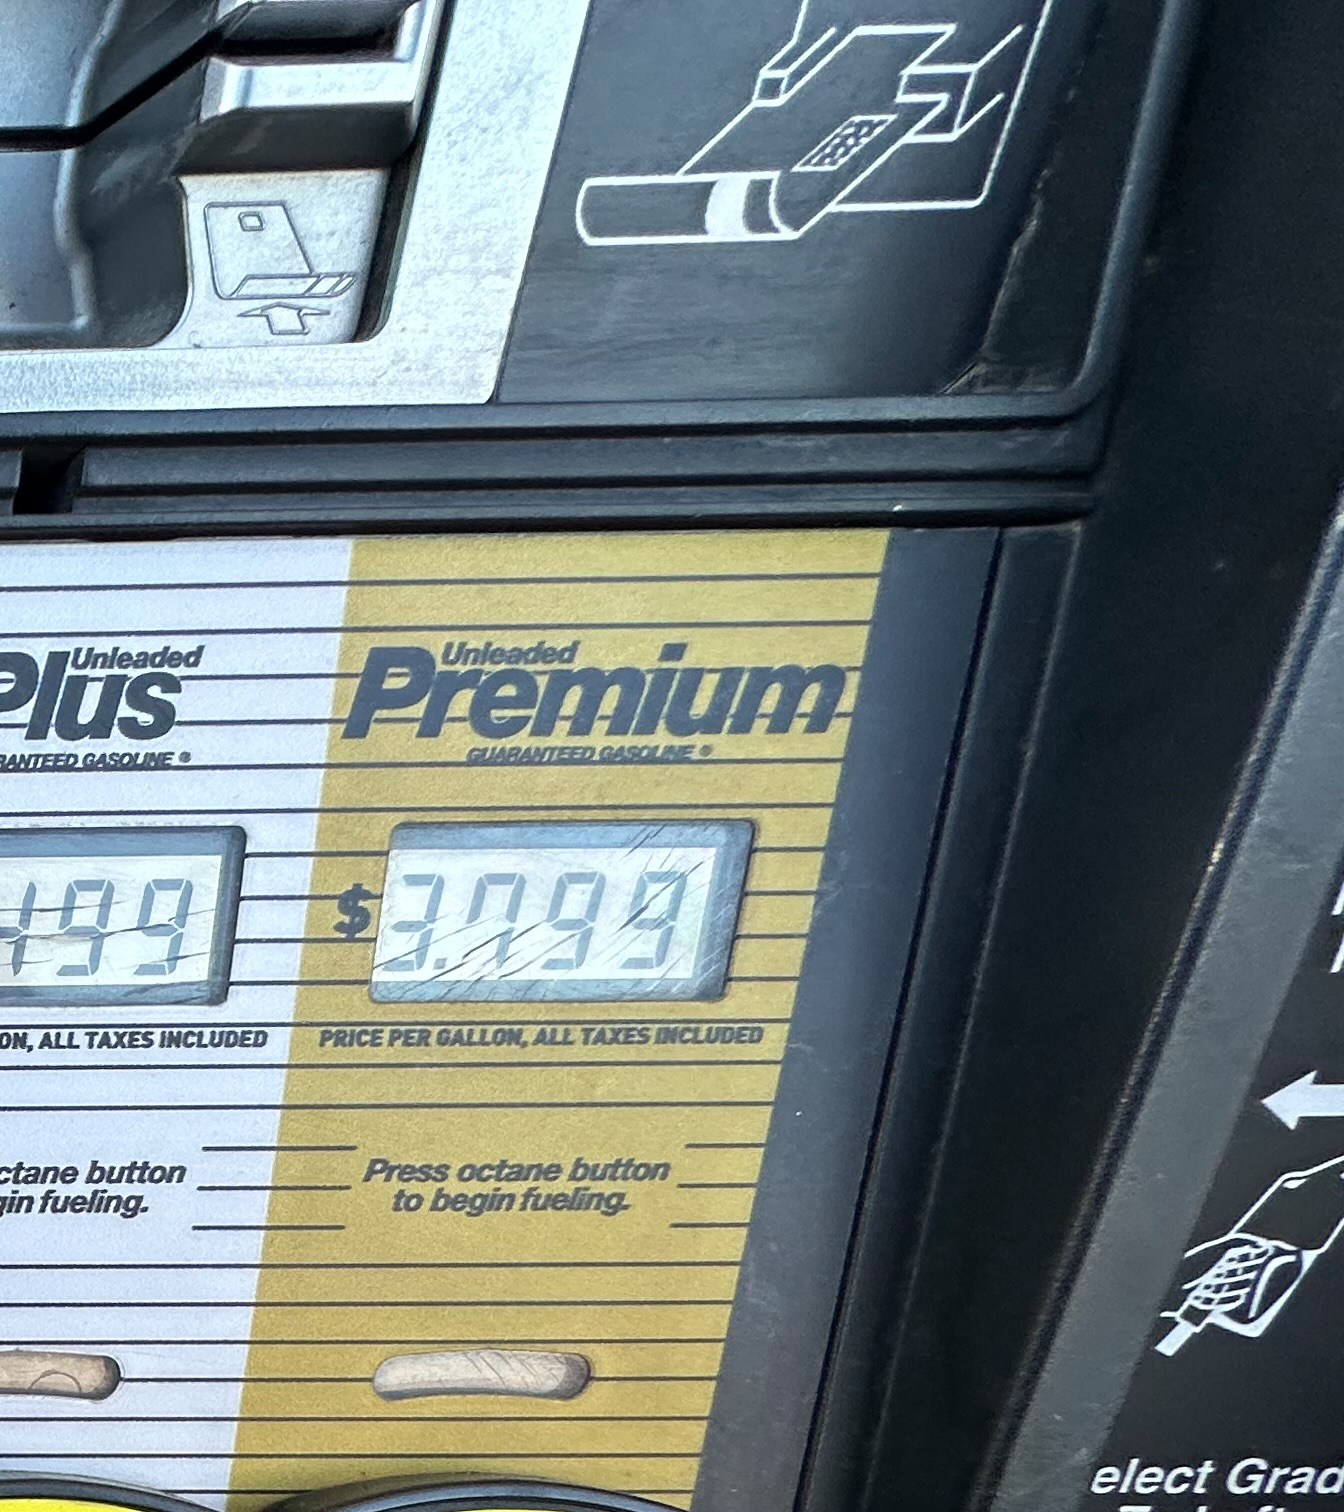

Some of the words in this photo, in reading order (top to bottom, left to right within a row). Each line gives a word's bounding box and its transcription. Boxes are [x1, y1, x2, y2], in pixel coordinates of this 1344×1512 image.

[71, 645, 205, 669] Unleaded
[441, 641, 580, 666] Unleaded
[341, 642, 846, 739] Premium
[467, 747, 595, 764] GUARANTEED
[333, 884, 371, 941] $
[38, 1032, 81, 1050] ALL
[85, 1031, 155, 1050] TAXES
[159, 1030, 268, 1049] INCLUDED
[319, 1028, 383, 1047] PRICE
[387, 1028, 431, 1047] PER
[436, 1028, 528, 1049] GALLON,
[532, 1028, 576, 1046] ALL
[580, 1027, 650, 1046] TAXES
[655, 1026, 764, 1045] INCLUDED
[88, 1161, 186, 1185] button
[362, 1157, 451, 1183] Press
[457, 1159, 562, 1183] octane
[568, 1157, 671, 1182] button
[38, 1189, 150, 1219] fueling.
[392, 1188, 424, 1213] to
[429, 1187, 516, 1217] begin
[518, 1186, 632, 1216] fueling.
[1090, 1457, 1217, 1494] elect
[1226, 1457, 1344, 1495] Grad
